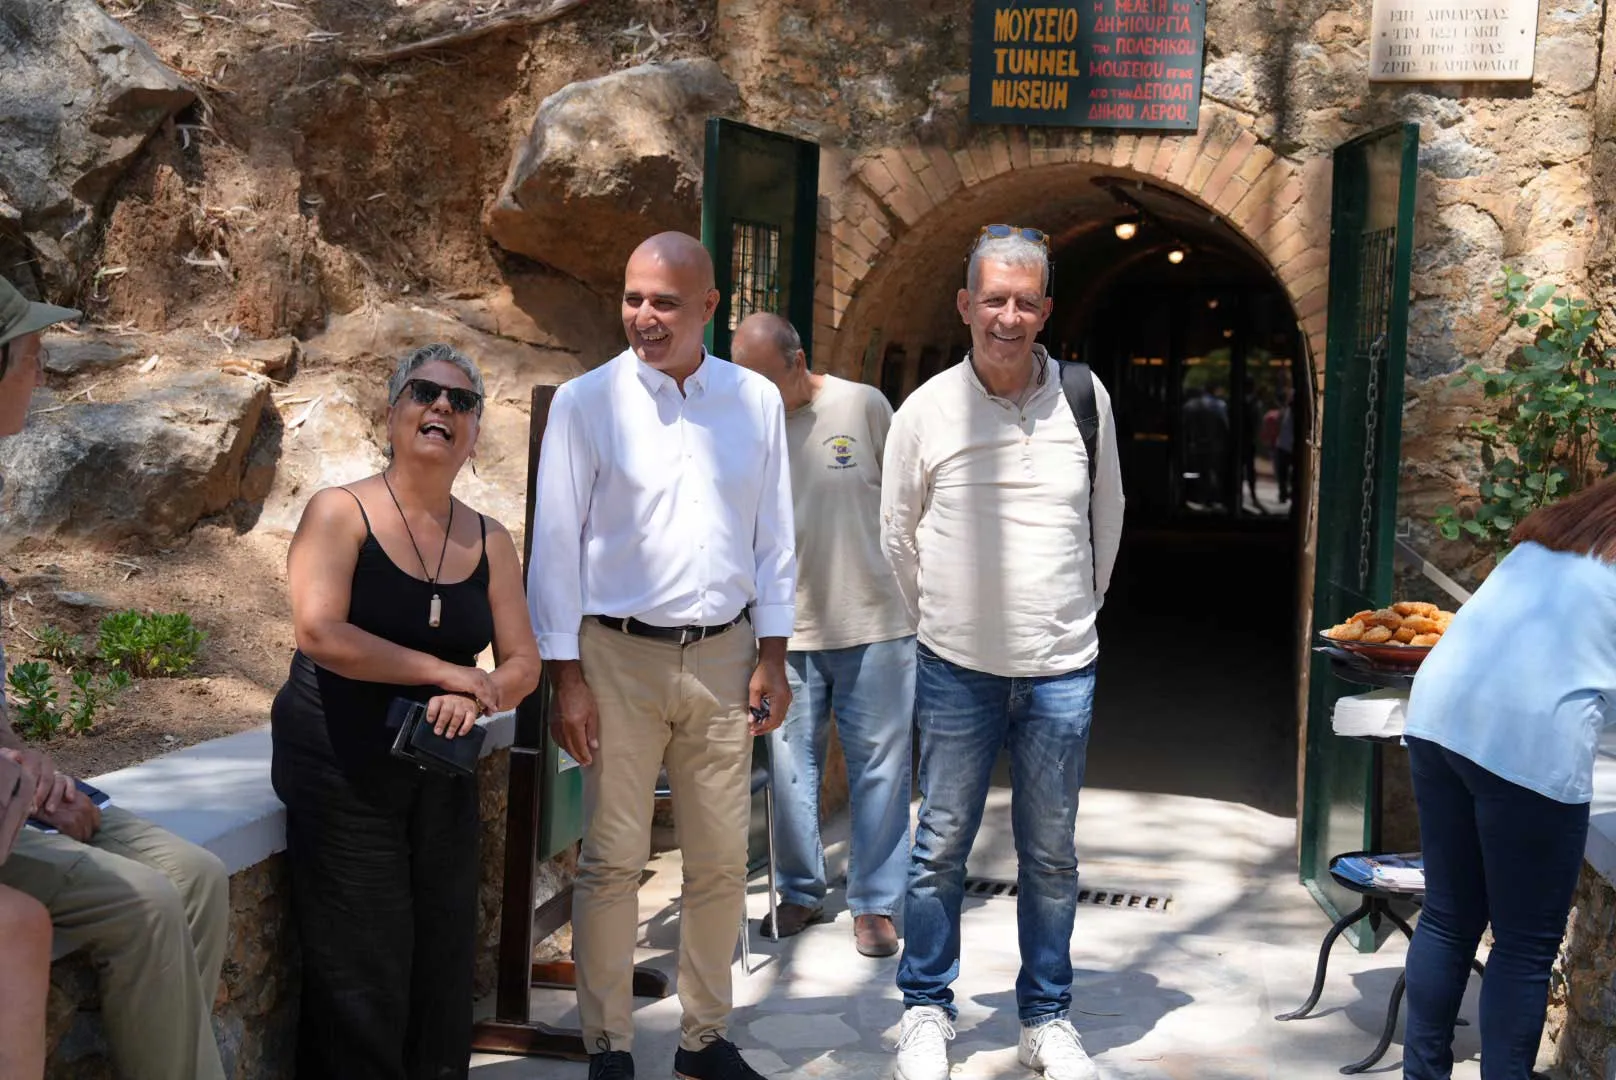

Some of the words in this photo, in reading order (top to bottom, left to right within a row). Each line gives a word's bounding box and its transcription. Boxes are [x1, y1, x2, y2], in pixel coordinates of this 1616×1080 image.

[994, 8, 1078, 42] ΜΟΥΣΕΙΟ
[994, 48, 1080, 76] TUNNEL
[991, 79, 1068, 109] MUSEUM
